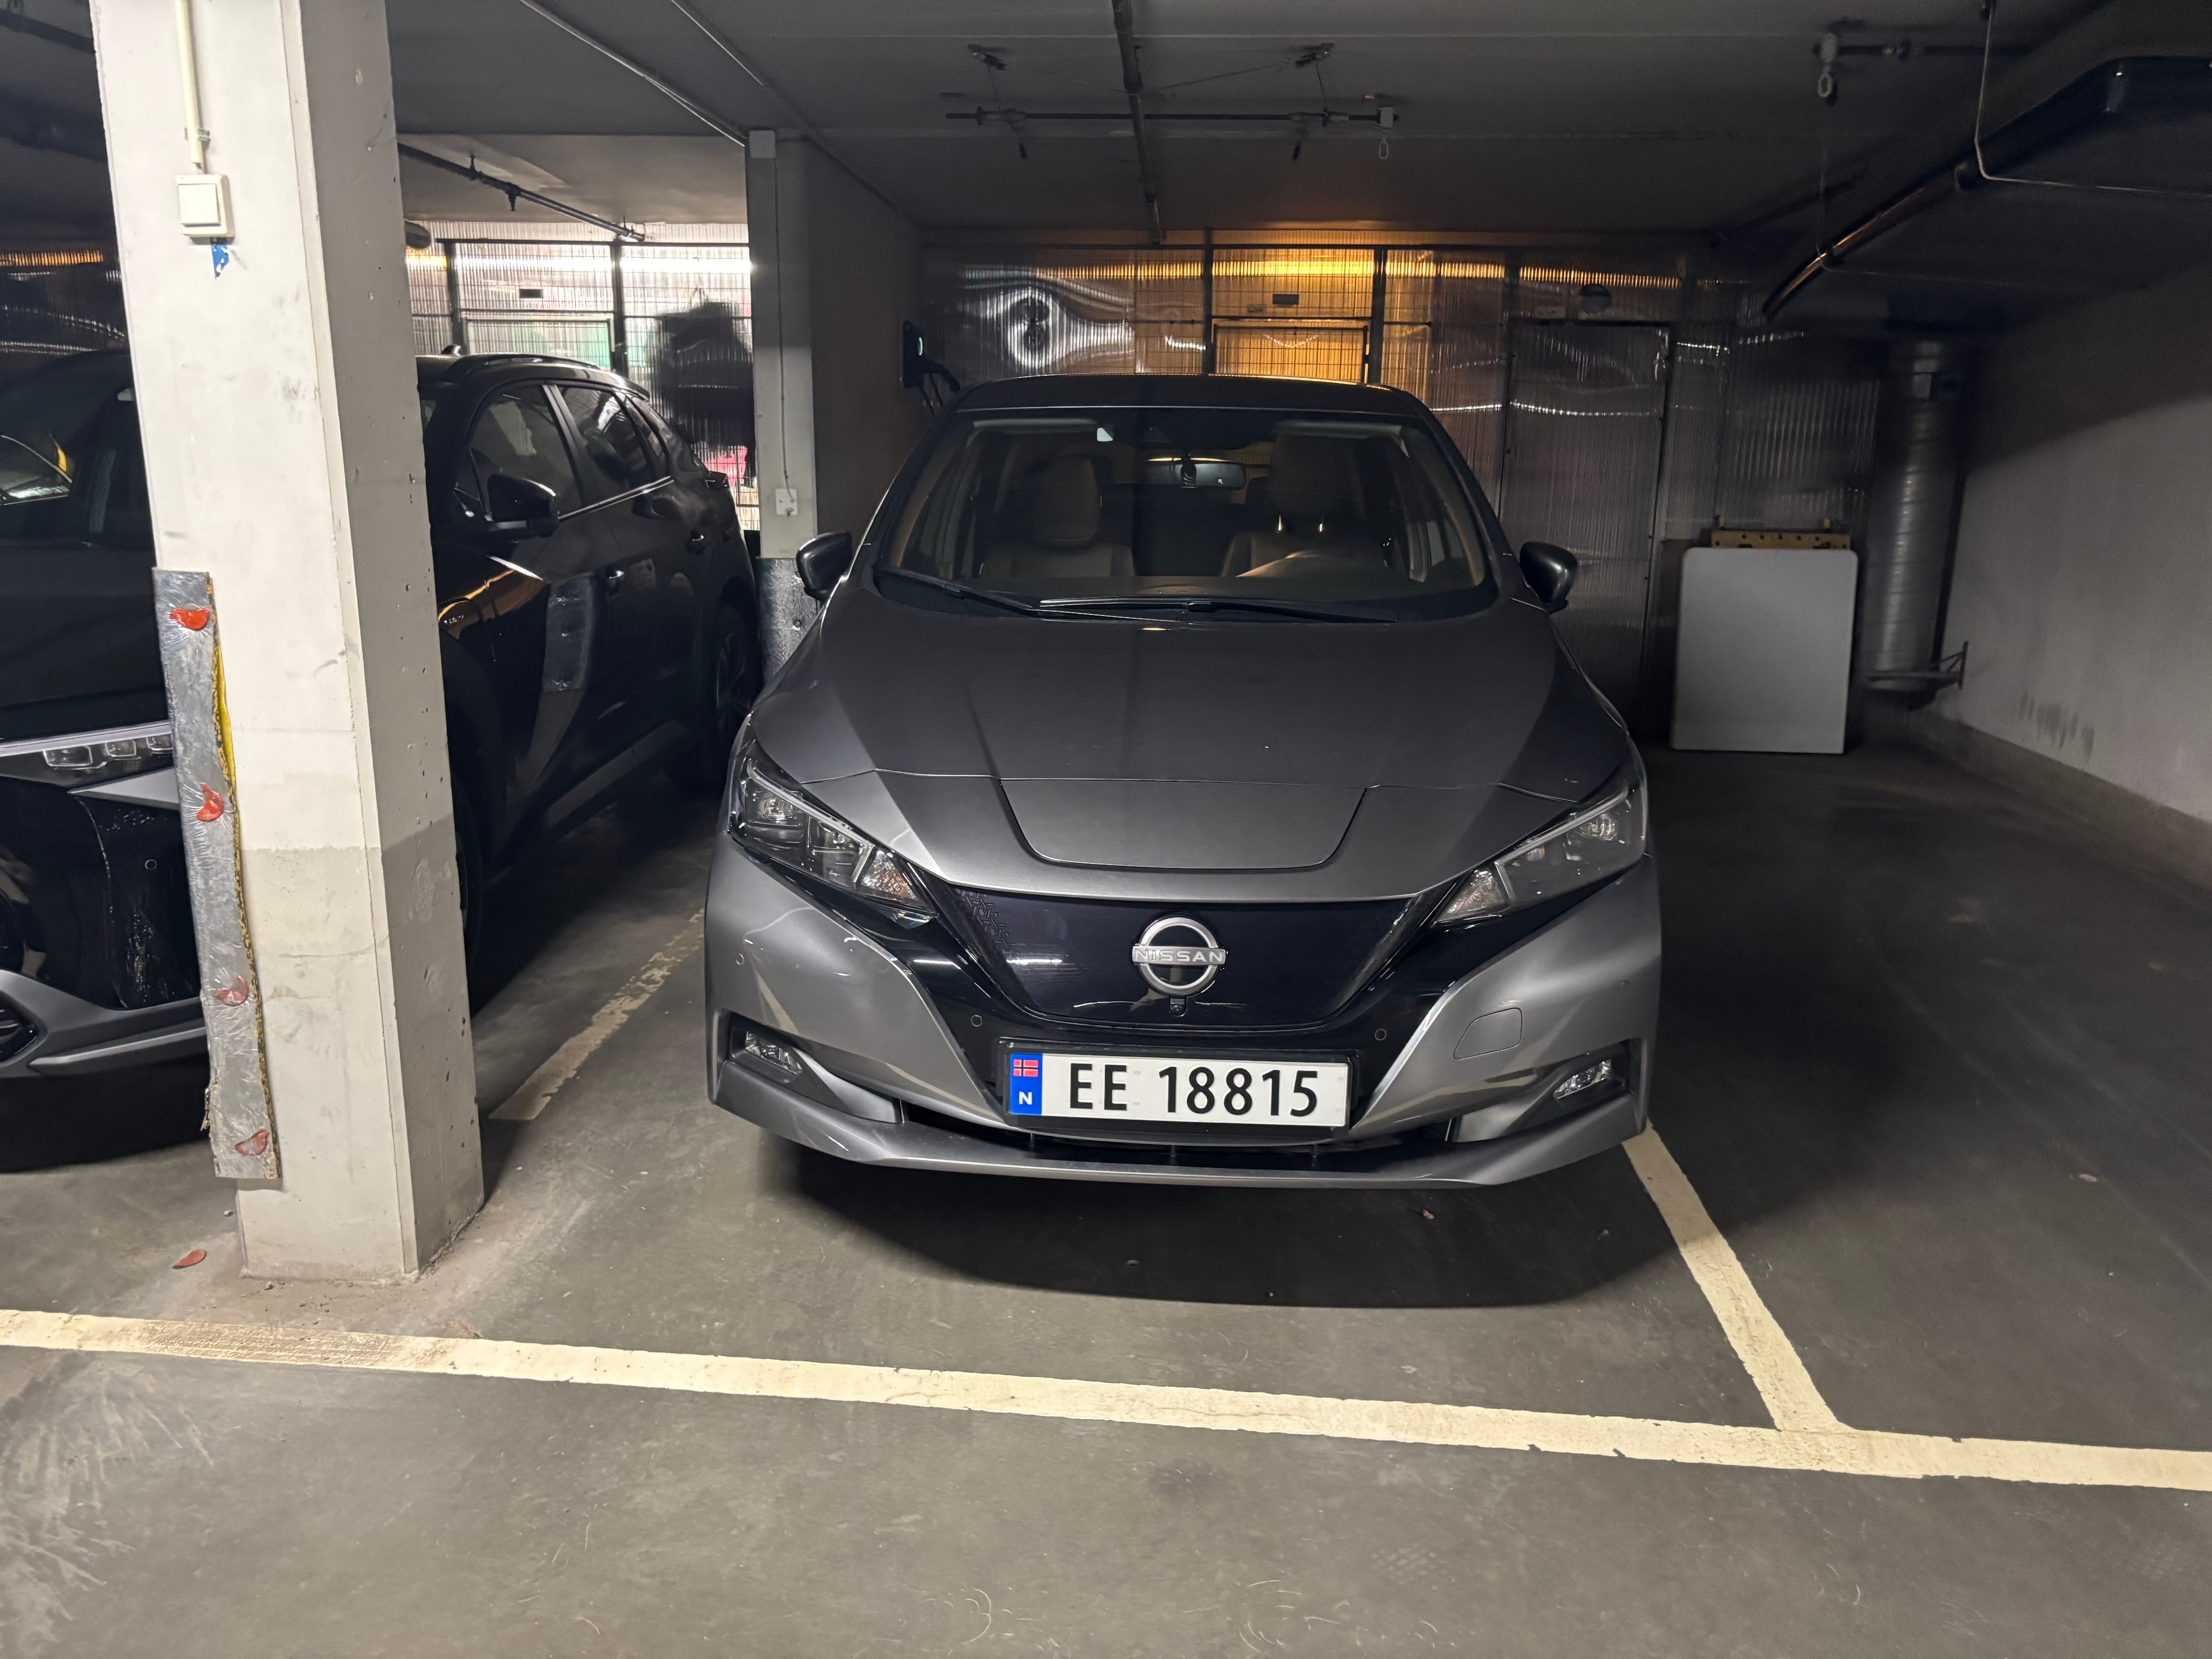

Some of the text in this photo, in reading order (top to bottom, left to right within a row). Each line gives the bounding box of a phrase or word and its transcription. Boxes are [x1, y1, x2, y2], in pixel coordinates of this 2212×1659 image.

[1134, 948, 1224, 962] NISSAN
[1070, 1063, 1317, 1117] EE 18815
[1019, 1091, 1032, 1105] N
